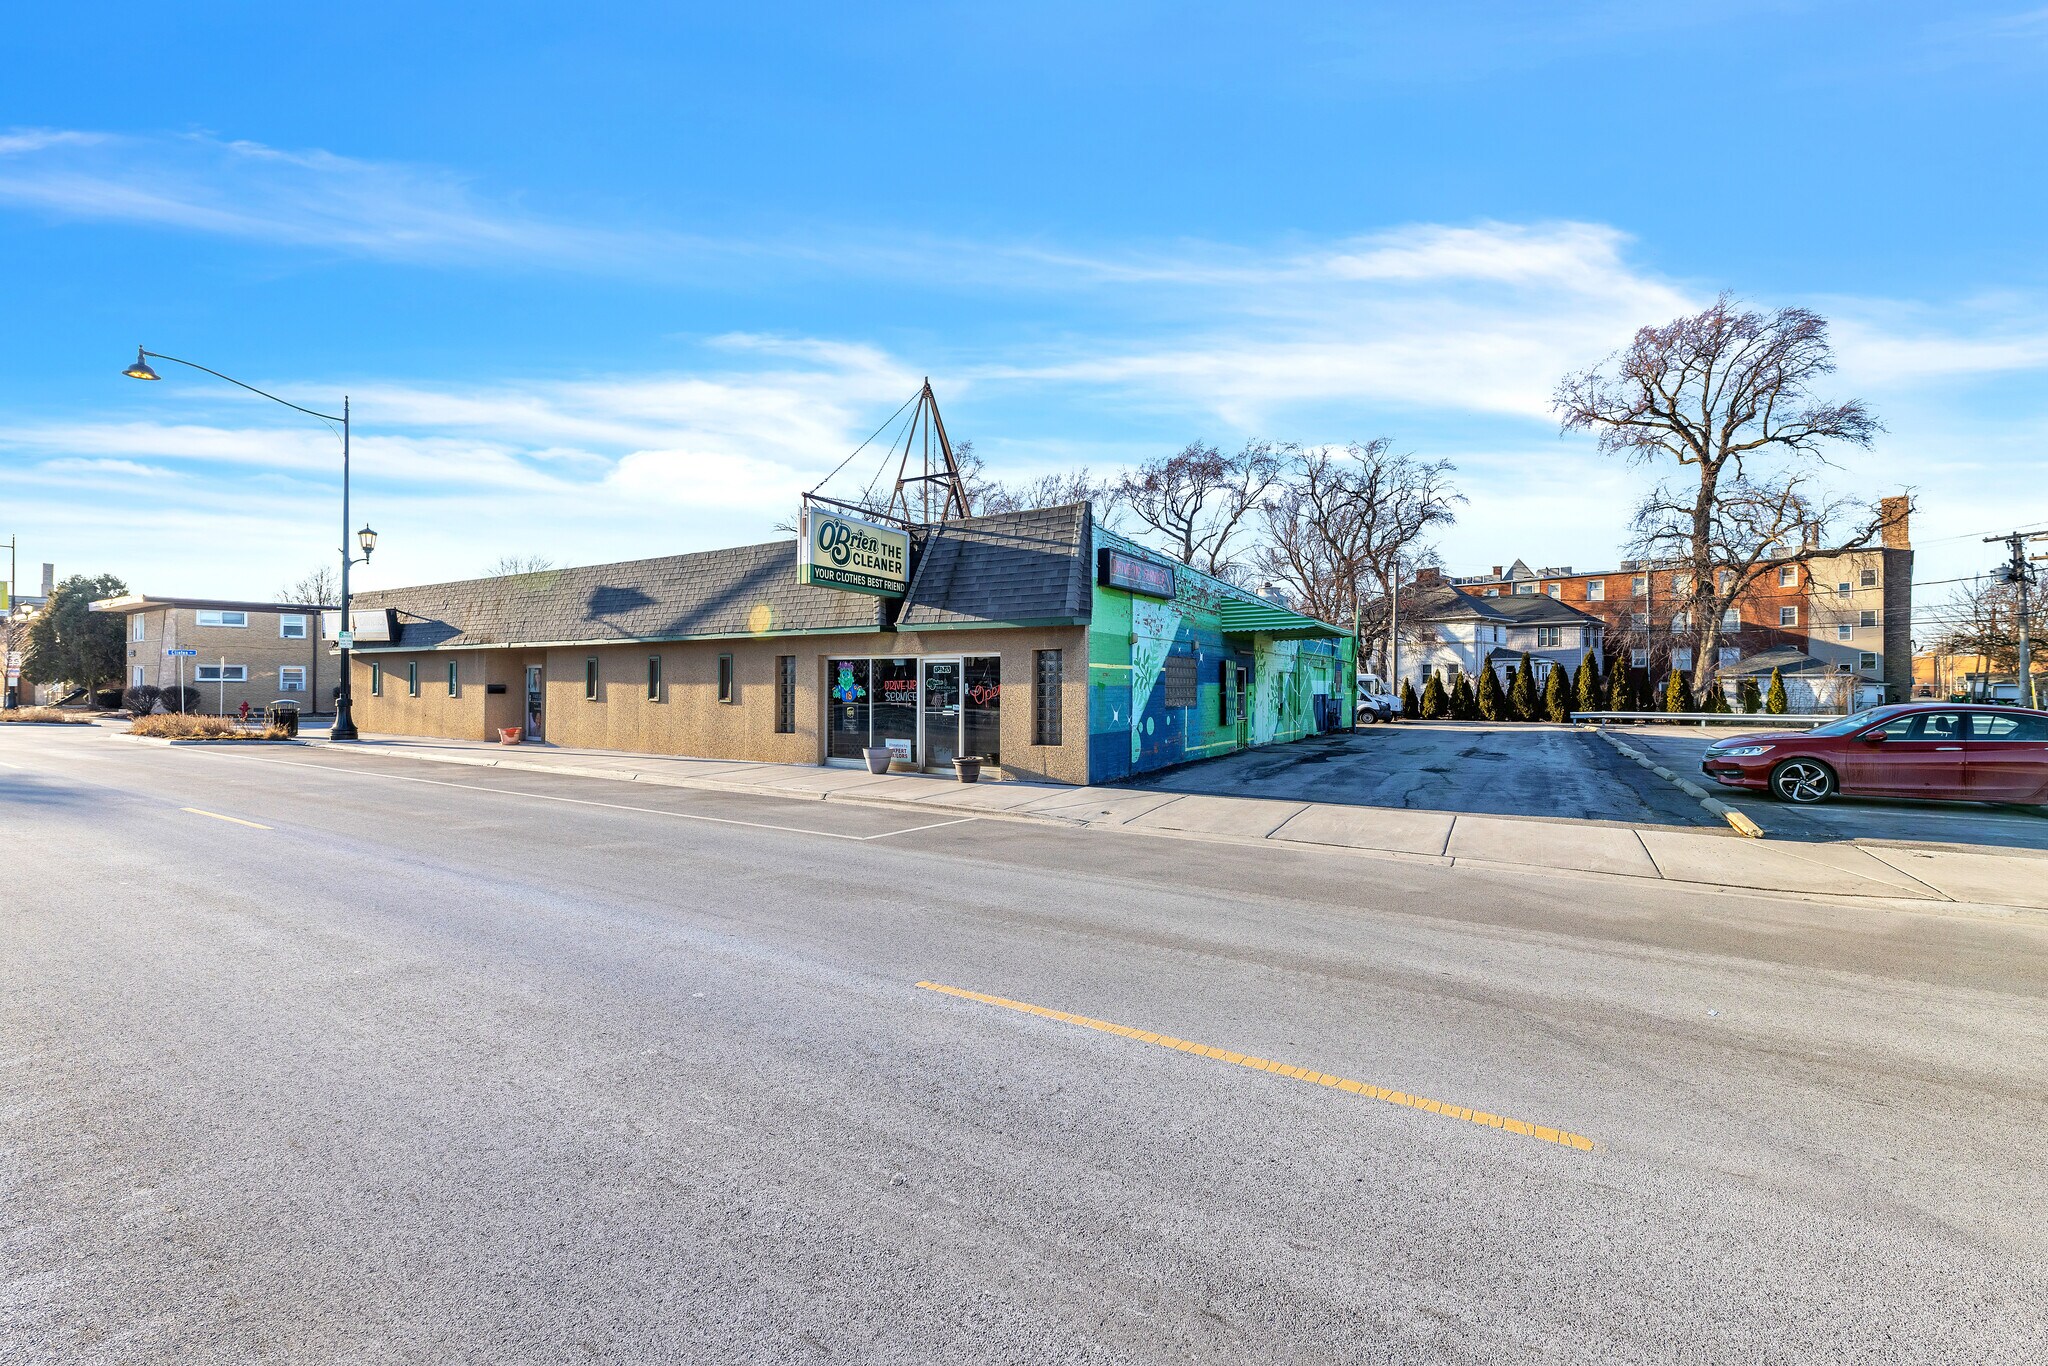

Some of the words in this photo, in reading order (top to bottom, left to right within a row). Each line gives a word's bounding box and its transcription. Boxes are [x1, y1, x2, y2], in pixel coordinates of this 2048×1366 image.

[818, 519, 878, 567] O'Brien
[881, 543, 902, 559] THE
[853, 552, 902, 574] CLEANER
[815, 567, 834, 580] YOUR
[836, 571, 866, 585] CLOTHES
[867, 577, 883, 587] BEST
[884, 580, 905, 592] FRIEND
[884, 691, 917, 701] SERVICE
